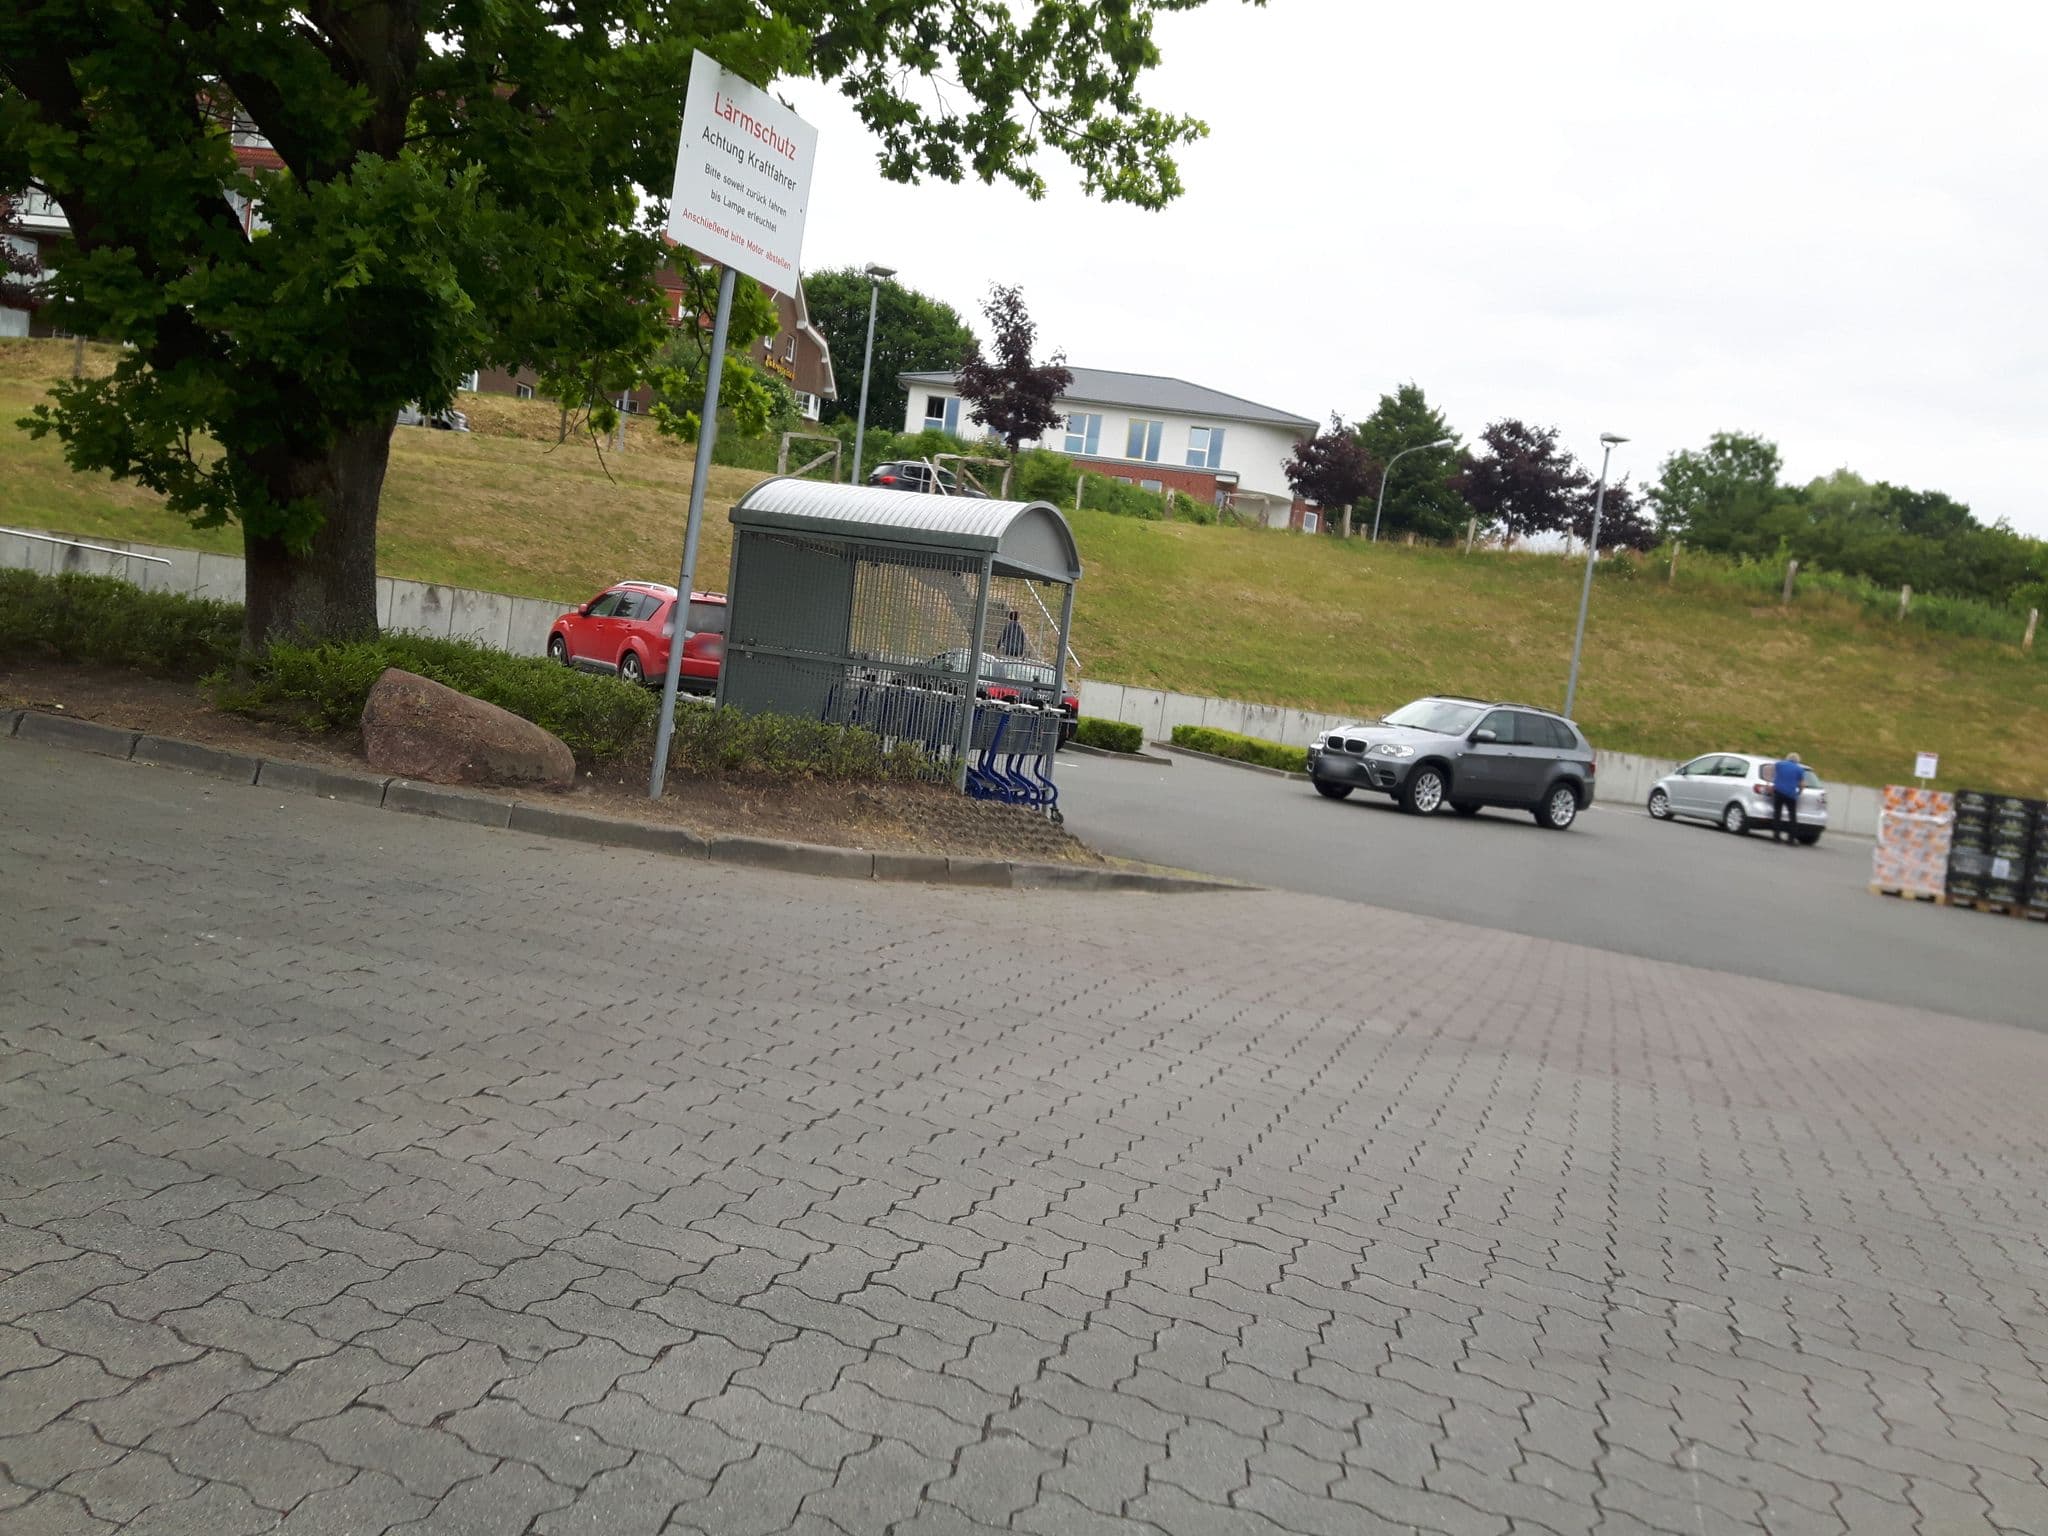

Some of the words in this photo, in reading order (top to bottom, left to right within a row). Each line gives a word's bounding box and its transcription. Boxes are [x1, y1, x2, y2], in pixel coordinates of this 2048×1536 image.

[714, 91, 797, 161] Lärmschutz
[702, 125, 744, 164] Achtung
[747, 150, 797, 192] Kraftfahrer
[704, 163, 721, 180] Bitte
[723, 175, 745, 193] soweit
[746, 187, 768, 206] zurück
[768, 199, 787, 217] fahren
[710, 189, 721, 203] bis
[723, 195, 746, 216] Lampe
[682, 208, 730, 238] Anschließend
[730, 231, 745, 246] bitte
[746, 239, 764, 256] Motor
[765, 250, 791, 271] abstellen
